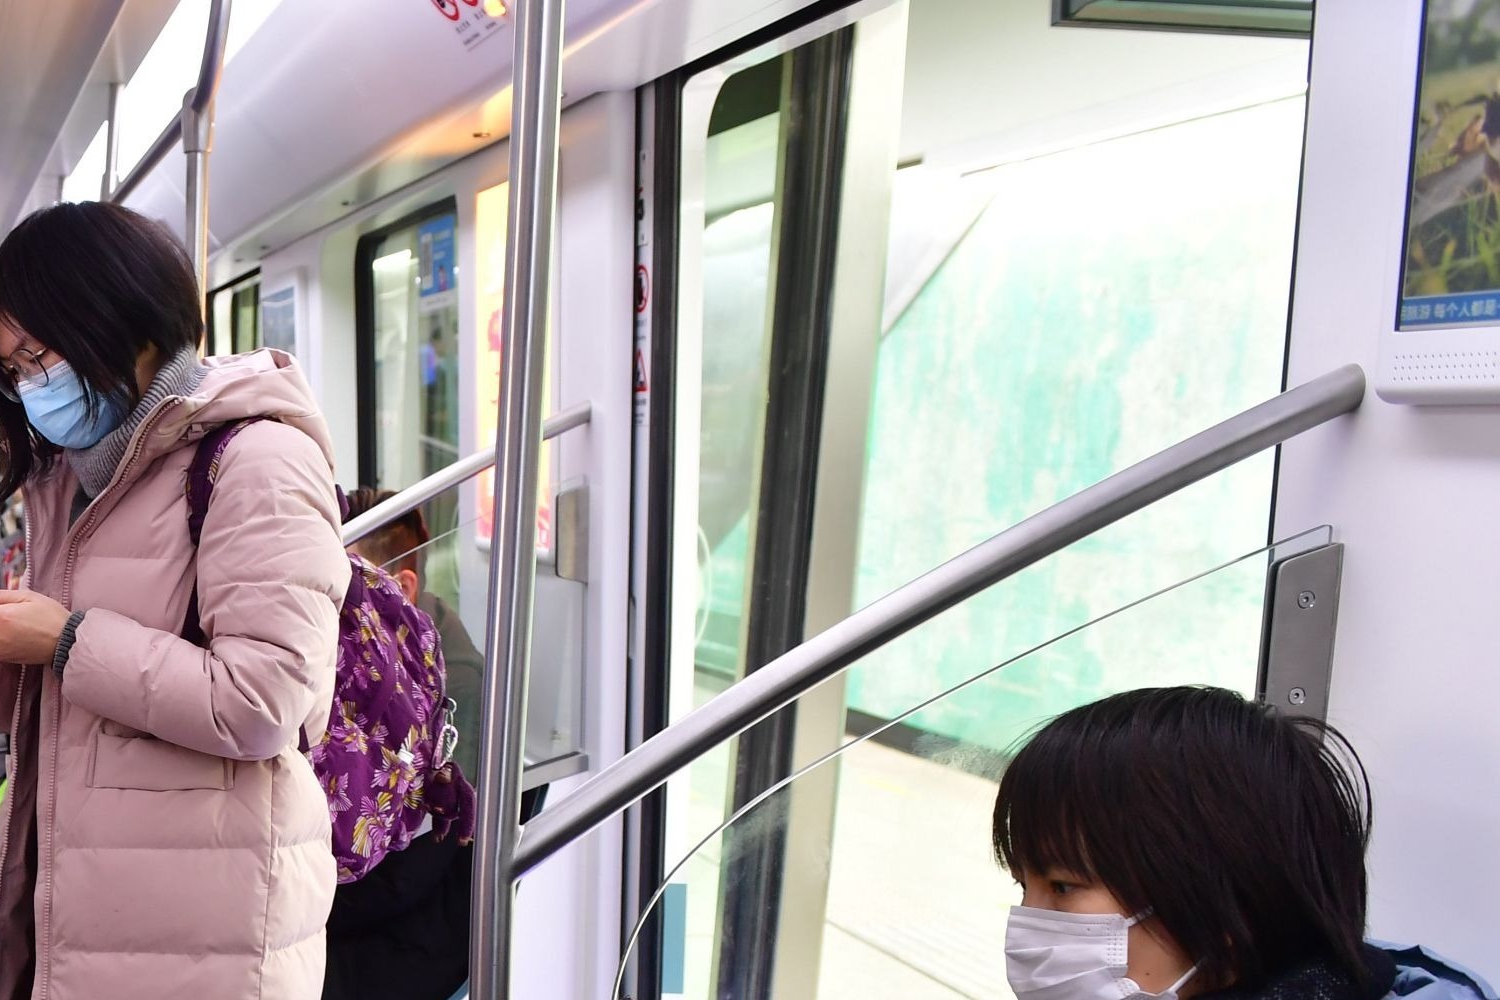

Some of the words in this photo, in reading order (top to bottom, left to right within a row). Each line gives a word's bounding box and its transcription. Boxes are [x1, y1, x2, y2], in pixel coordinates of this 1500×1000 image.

[1434, 299, 1500, 319] 每个人都是
